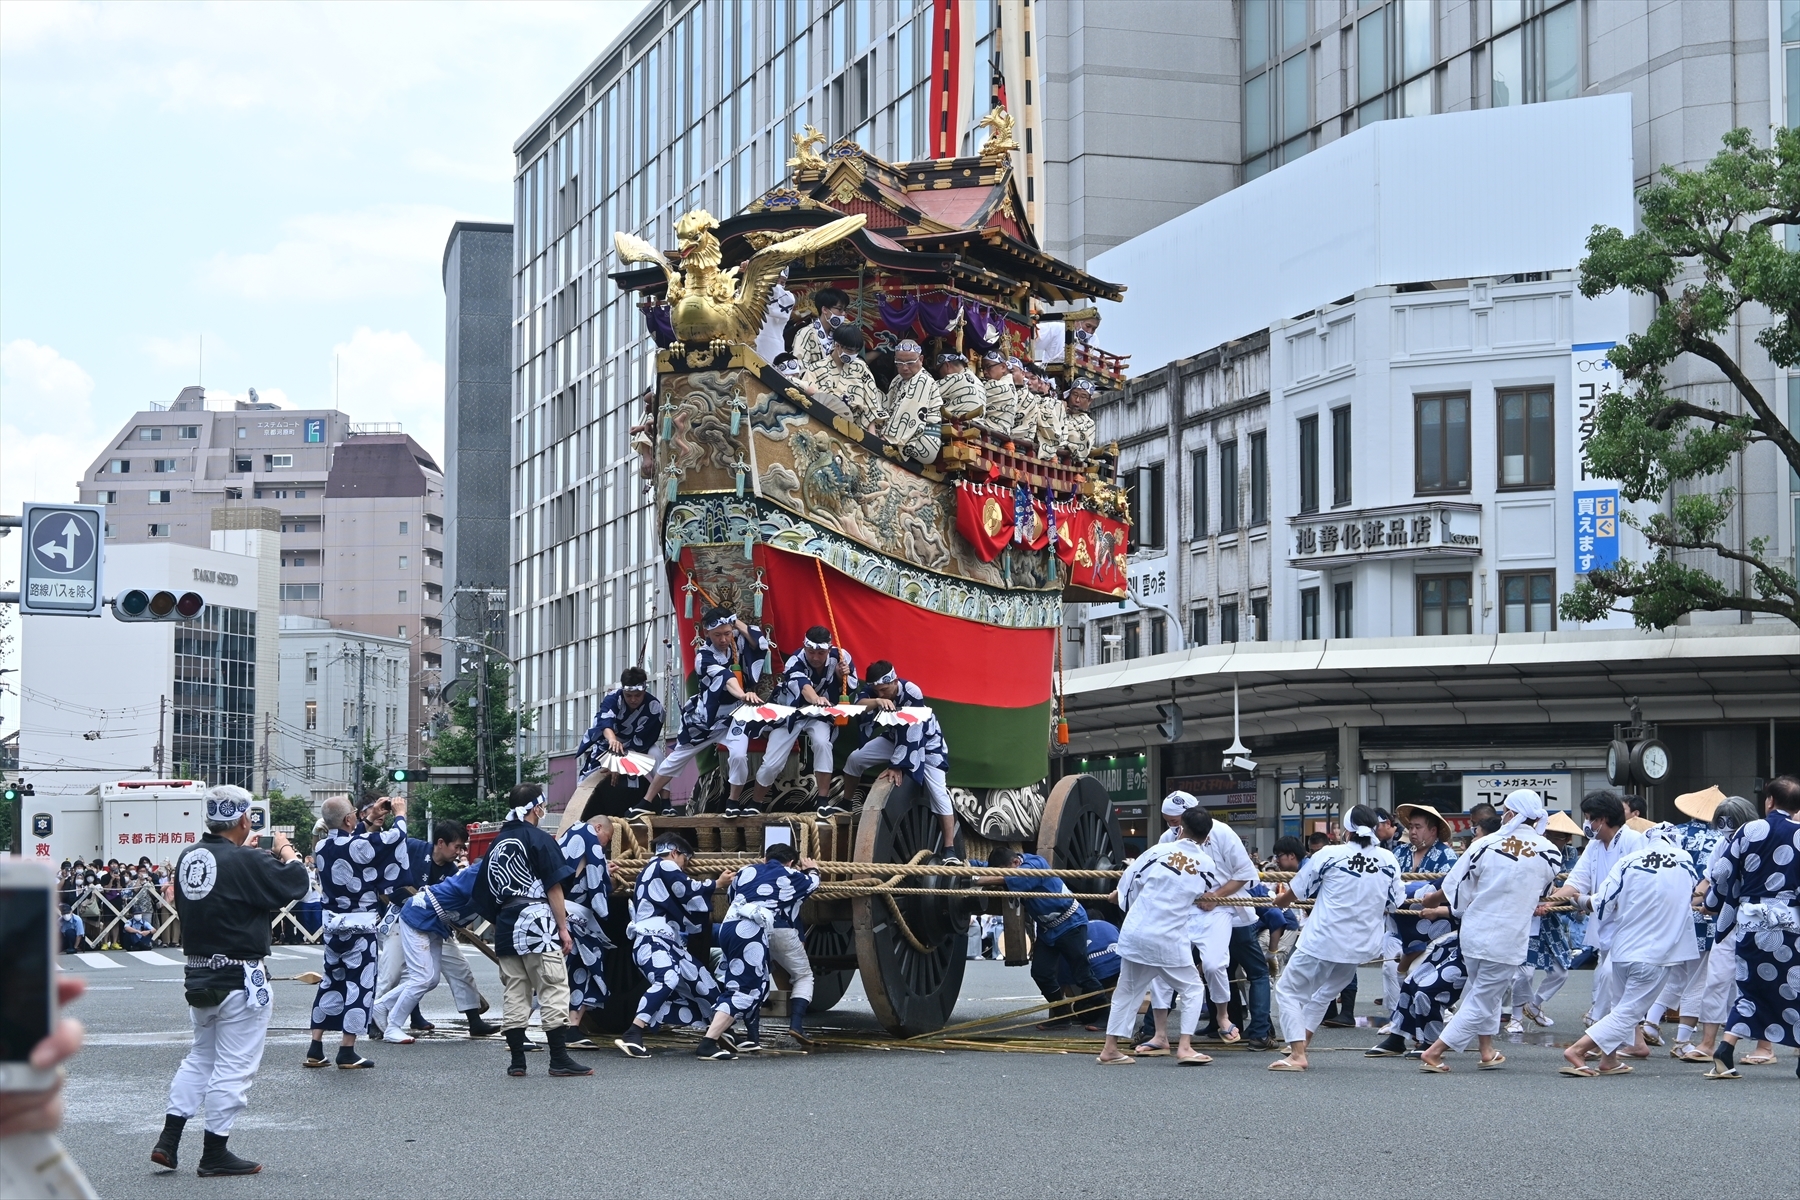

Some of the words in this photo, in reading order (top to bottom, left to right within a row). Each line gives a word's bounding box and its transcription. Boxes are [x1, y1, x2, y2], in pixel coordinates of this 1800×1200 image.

[1597, 498, 1613, 536] すぐ
[1296, 515, 1431, 554] 池善化粧品店
[1578, 498, 1595, 571] 買えます
[217, 571, 239, 587] SEED
[1142, 570, 1166, 597] 雲の茶
[29, 583, 93, 599] 路線バスを除く
[1502, 778, 1558, 787] メガネスーパー
[1227, 794, 1242, 804] ACCESS
[1477, 790, 1558, 807] コント
[118, 832, 196, 845] 京都市消防局
